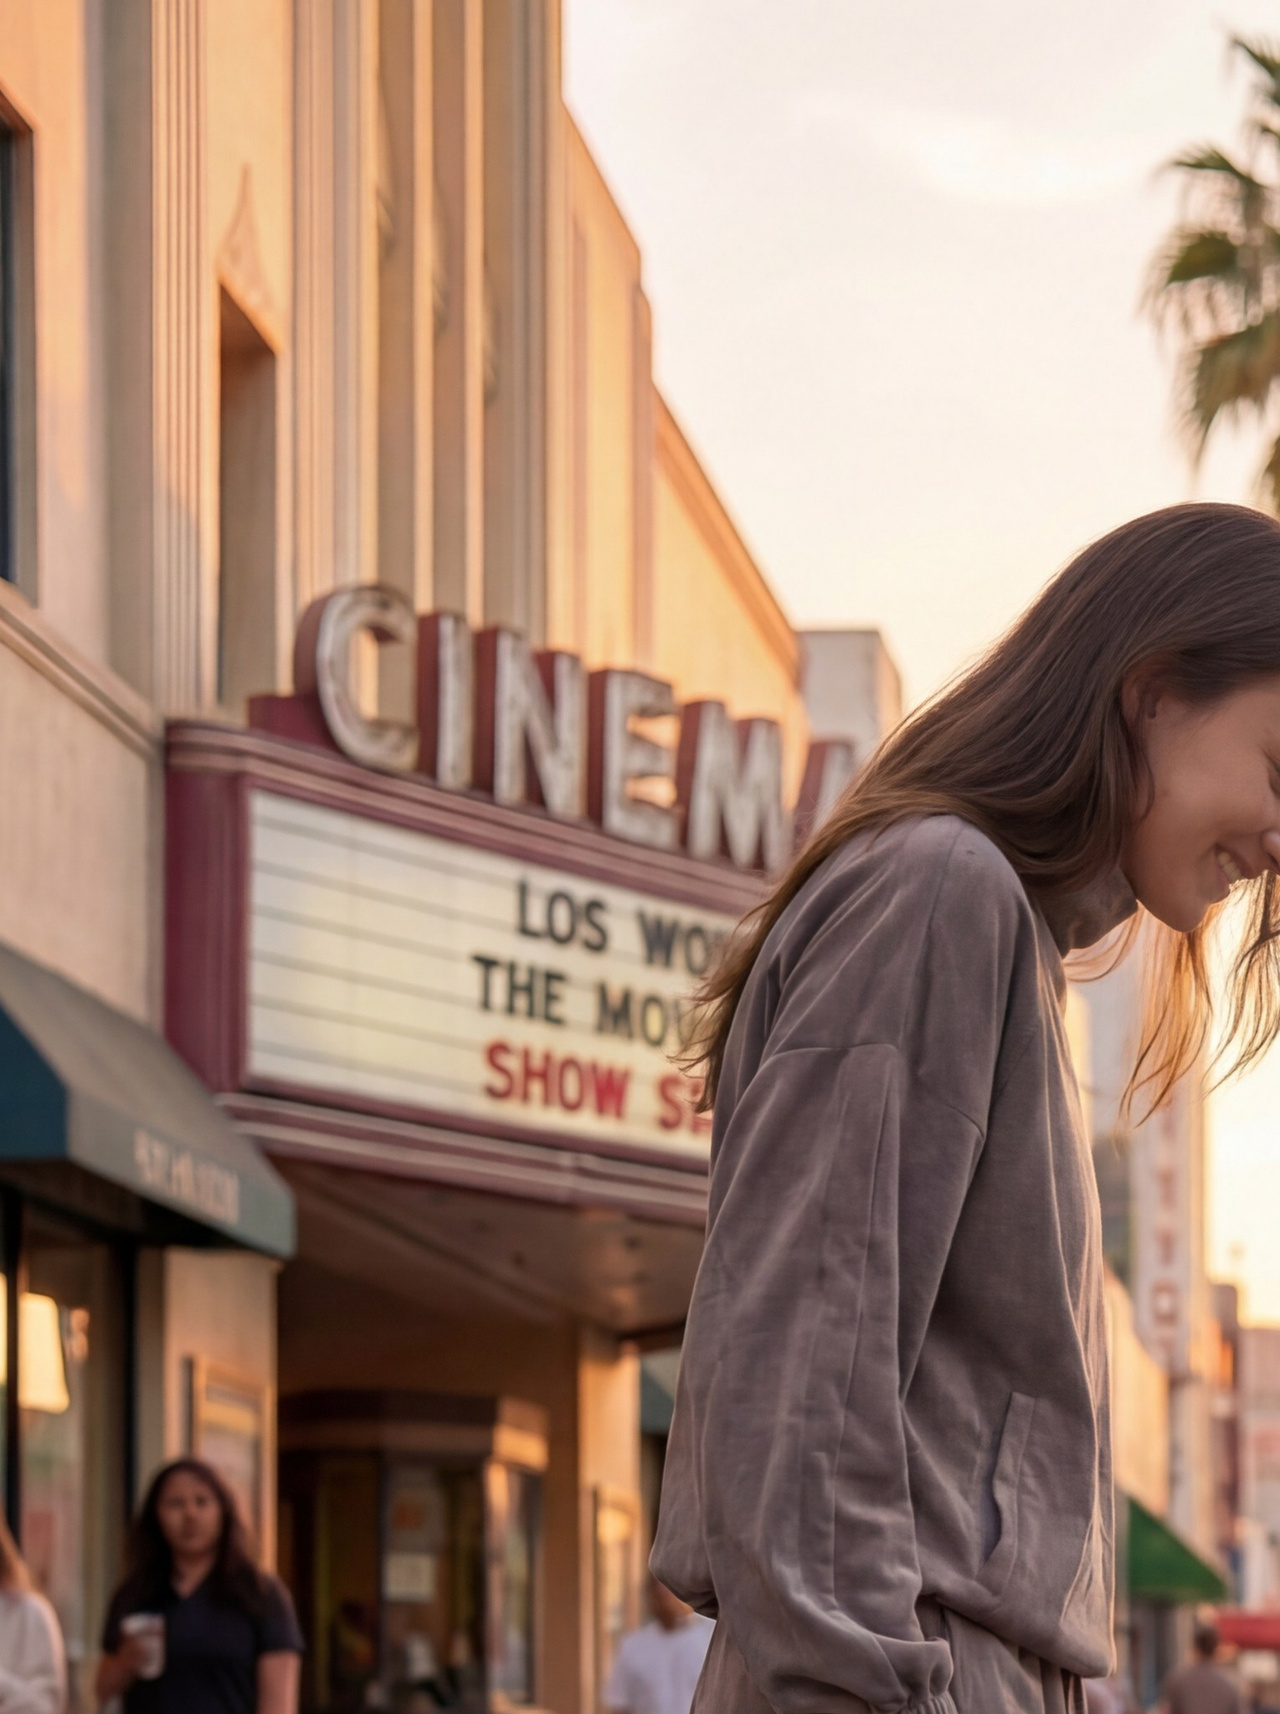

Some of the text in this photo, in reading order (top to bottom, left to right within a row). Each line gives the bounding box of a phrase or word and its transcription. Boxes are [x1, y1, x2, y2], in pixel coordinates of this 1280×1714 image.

[516, 879, 730, 977] LOS WO
[472, 953, 567, 1026] THE
[484, 1038, 629, 1120] SHOW
